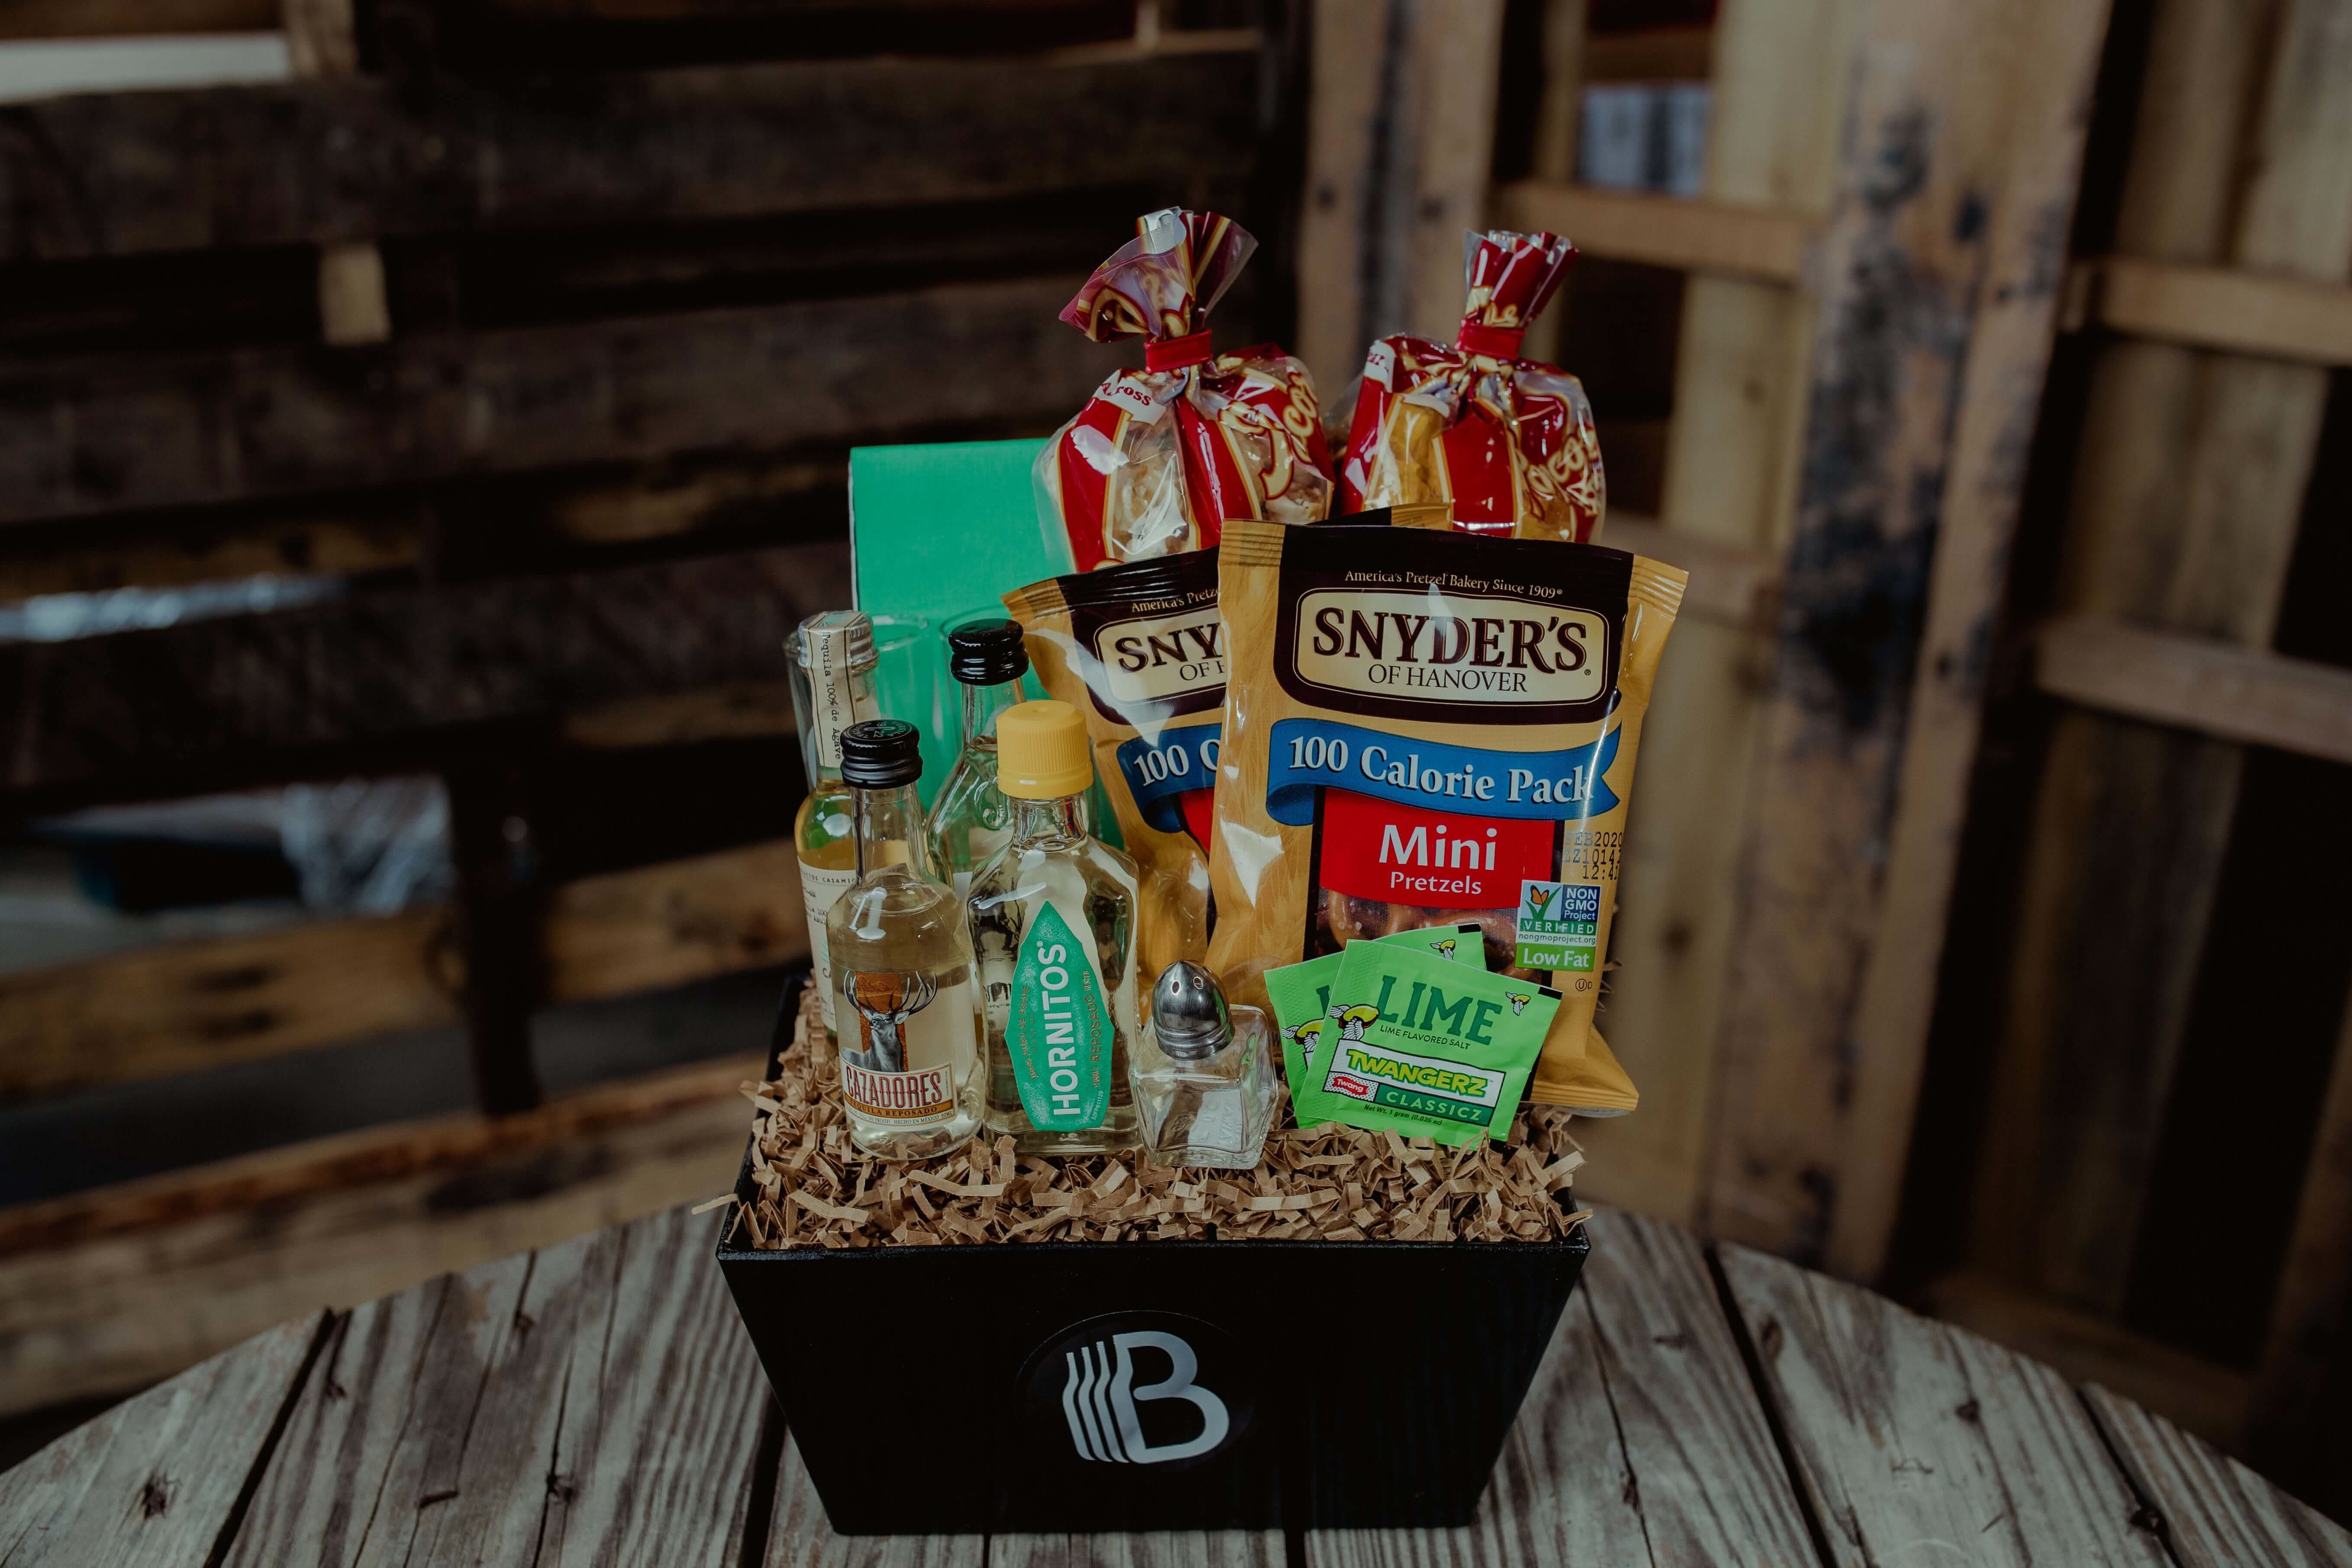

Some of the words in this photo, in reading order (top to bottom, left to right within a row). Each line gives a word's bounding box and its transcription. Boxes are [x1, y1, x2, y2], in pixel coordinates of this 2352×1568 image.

[1344, 570, 1402, 583] America's
[1406, 571, 1445, 585] Pretzel
[1450, 574, 1490, 593] Bakery
[1493, 578, 1525, 594] Since
[1132, 597, 1185, 613] America's
[1313, 607, 1587, 674] SNYDER'S
[821, 632, 832, 677] Tequila
[1180, 662, 1210, 681] OF
[1368, 663, 1401, 684] OF
[1406, 666, 1528, 693] HANOVER
[826, 683, 839, 706] 100%
[831, 710, 839, 722] de
[832, 728, 841, 759] Agave
[1133, 745, 1190, 787] 100
[1289, 735, 1349, 773] 100
[1361, 745, 1494, 802] Calorie
[1508, 765, 1595, 805] Pack
[1378, 824, 1497, 871] Mini
[1390, 871, 1482, 895] Pretzels
[1567, 887, 1597, 900] NON
[1564, 910, 1596, 922] Project
[1565, 899, 1597, 911] GMO
[1519, 934, 1596, 945] nongmoproject.org
[1524, 921, 1594, 934] VERIFIED
[1523, 948, 1560, 966] Low
[1564, 950, 1590, 968] Fat
[1374, 974, 1503, 1046] LIME
[1018, 1017, 1026, 1029] DE
[1038, 944, 1081, 1116] HORNITOS
[1084, 993, 1102, 1064] REPOSADO
[1380, 1025, 1402, 1036] LIME
[1403, 1031, 1448, 1046] FLAVORED
[1449, 1039, 1471, 1051] SALT
[1336, 1078, 1365, 1094] Twang
[1346, 1049, 1489, 1099] TWANGERZ
[846, 1065, 943, 1108] CAZADORES
[851, 1098, 882, 1115] TEQUILA
[885, 1106, 938, 1116] REPOSADO
[1385, 1091, 1482, 1122] CLASSICZ
[920, 1115, 939, 1123] MEXICO
